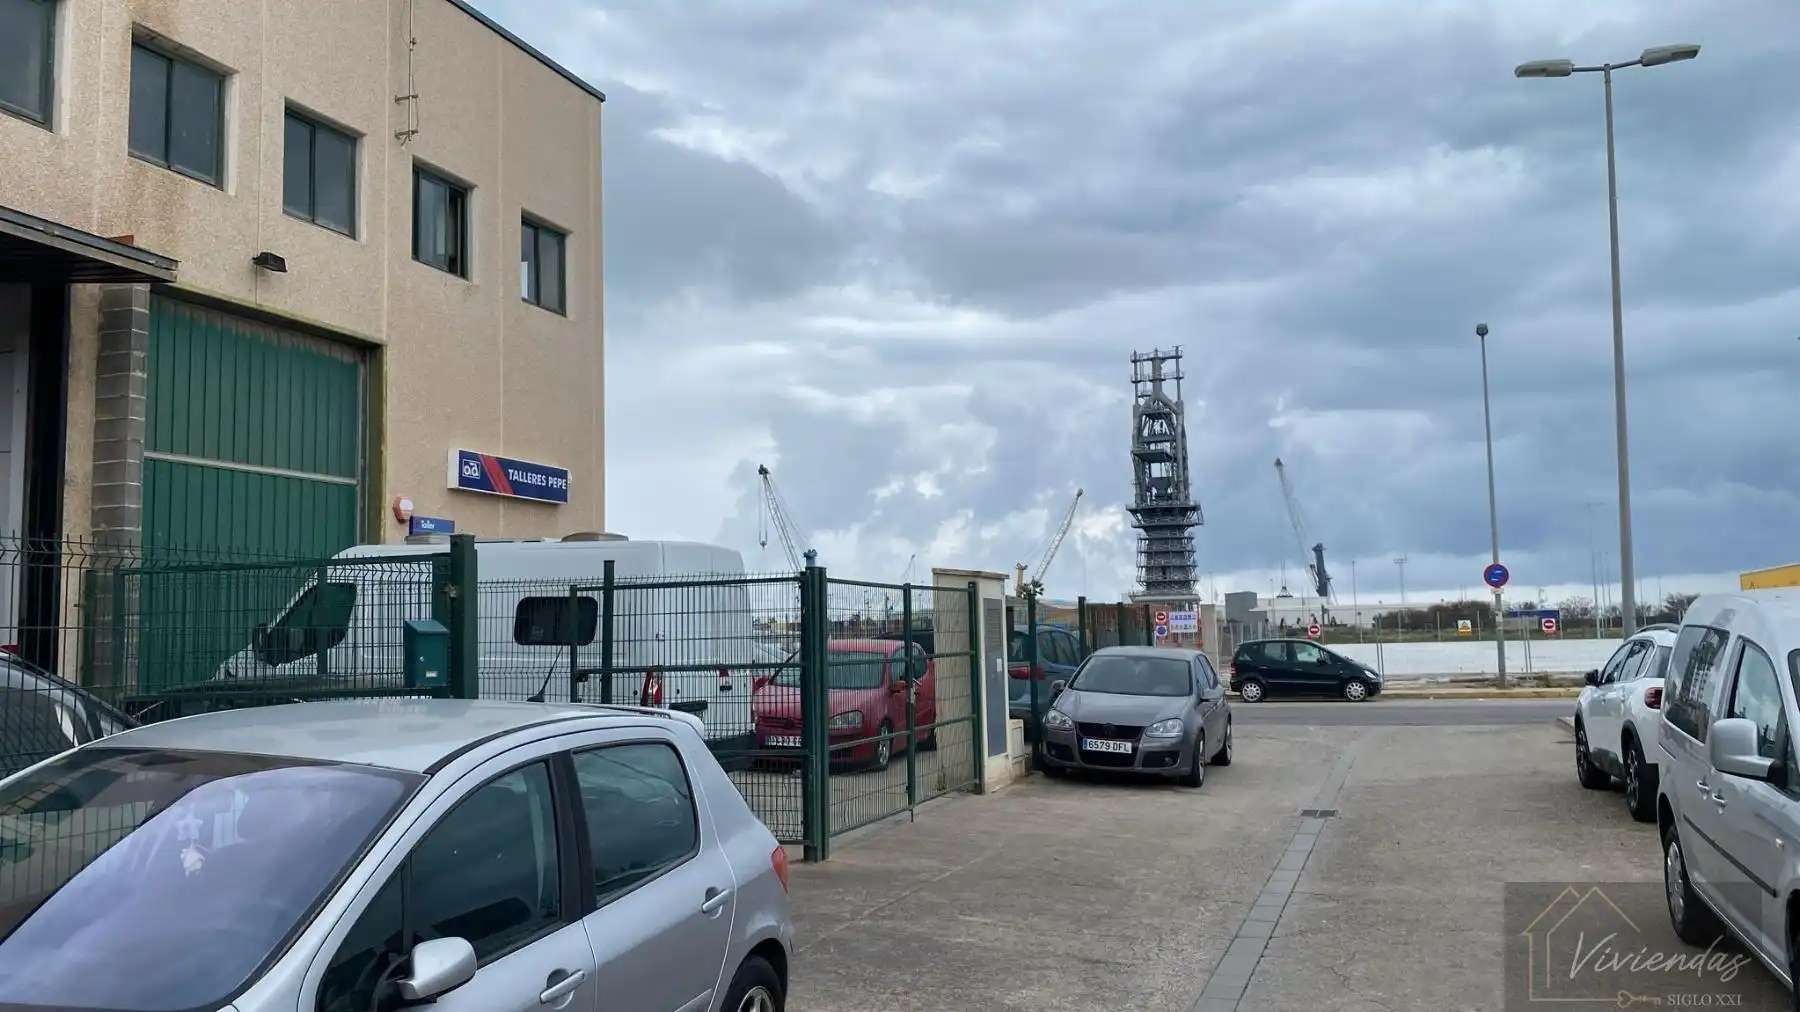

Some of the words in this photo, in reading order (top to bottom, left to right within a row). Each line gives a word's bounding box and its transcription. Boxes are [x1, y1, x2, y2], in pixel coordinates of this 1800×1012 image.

[508, 469, 546, 486] TALLERES
[548, 476, 567, 490] PEPE
[1088, 740, 1111, 750] 6579
[1112, 742, 1130, 752] DFL
